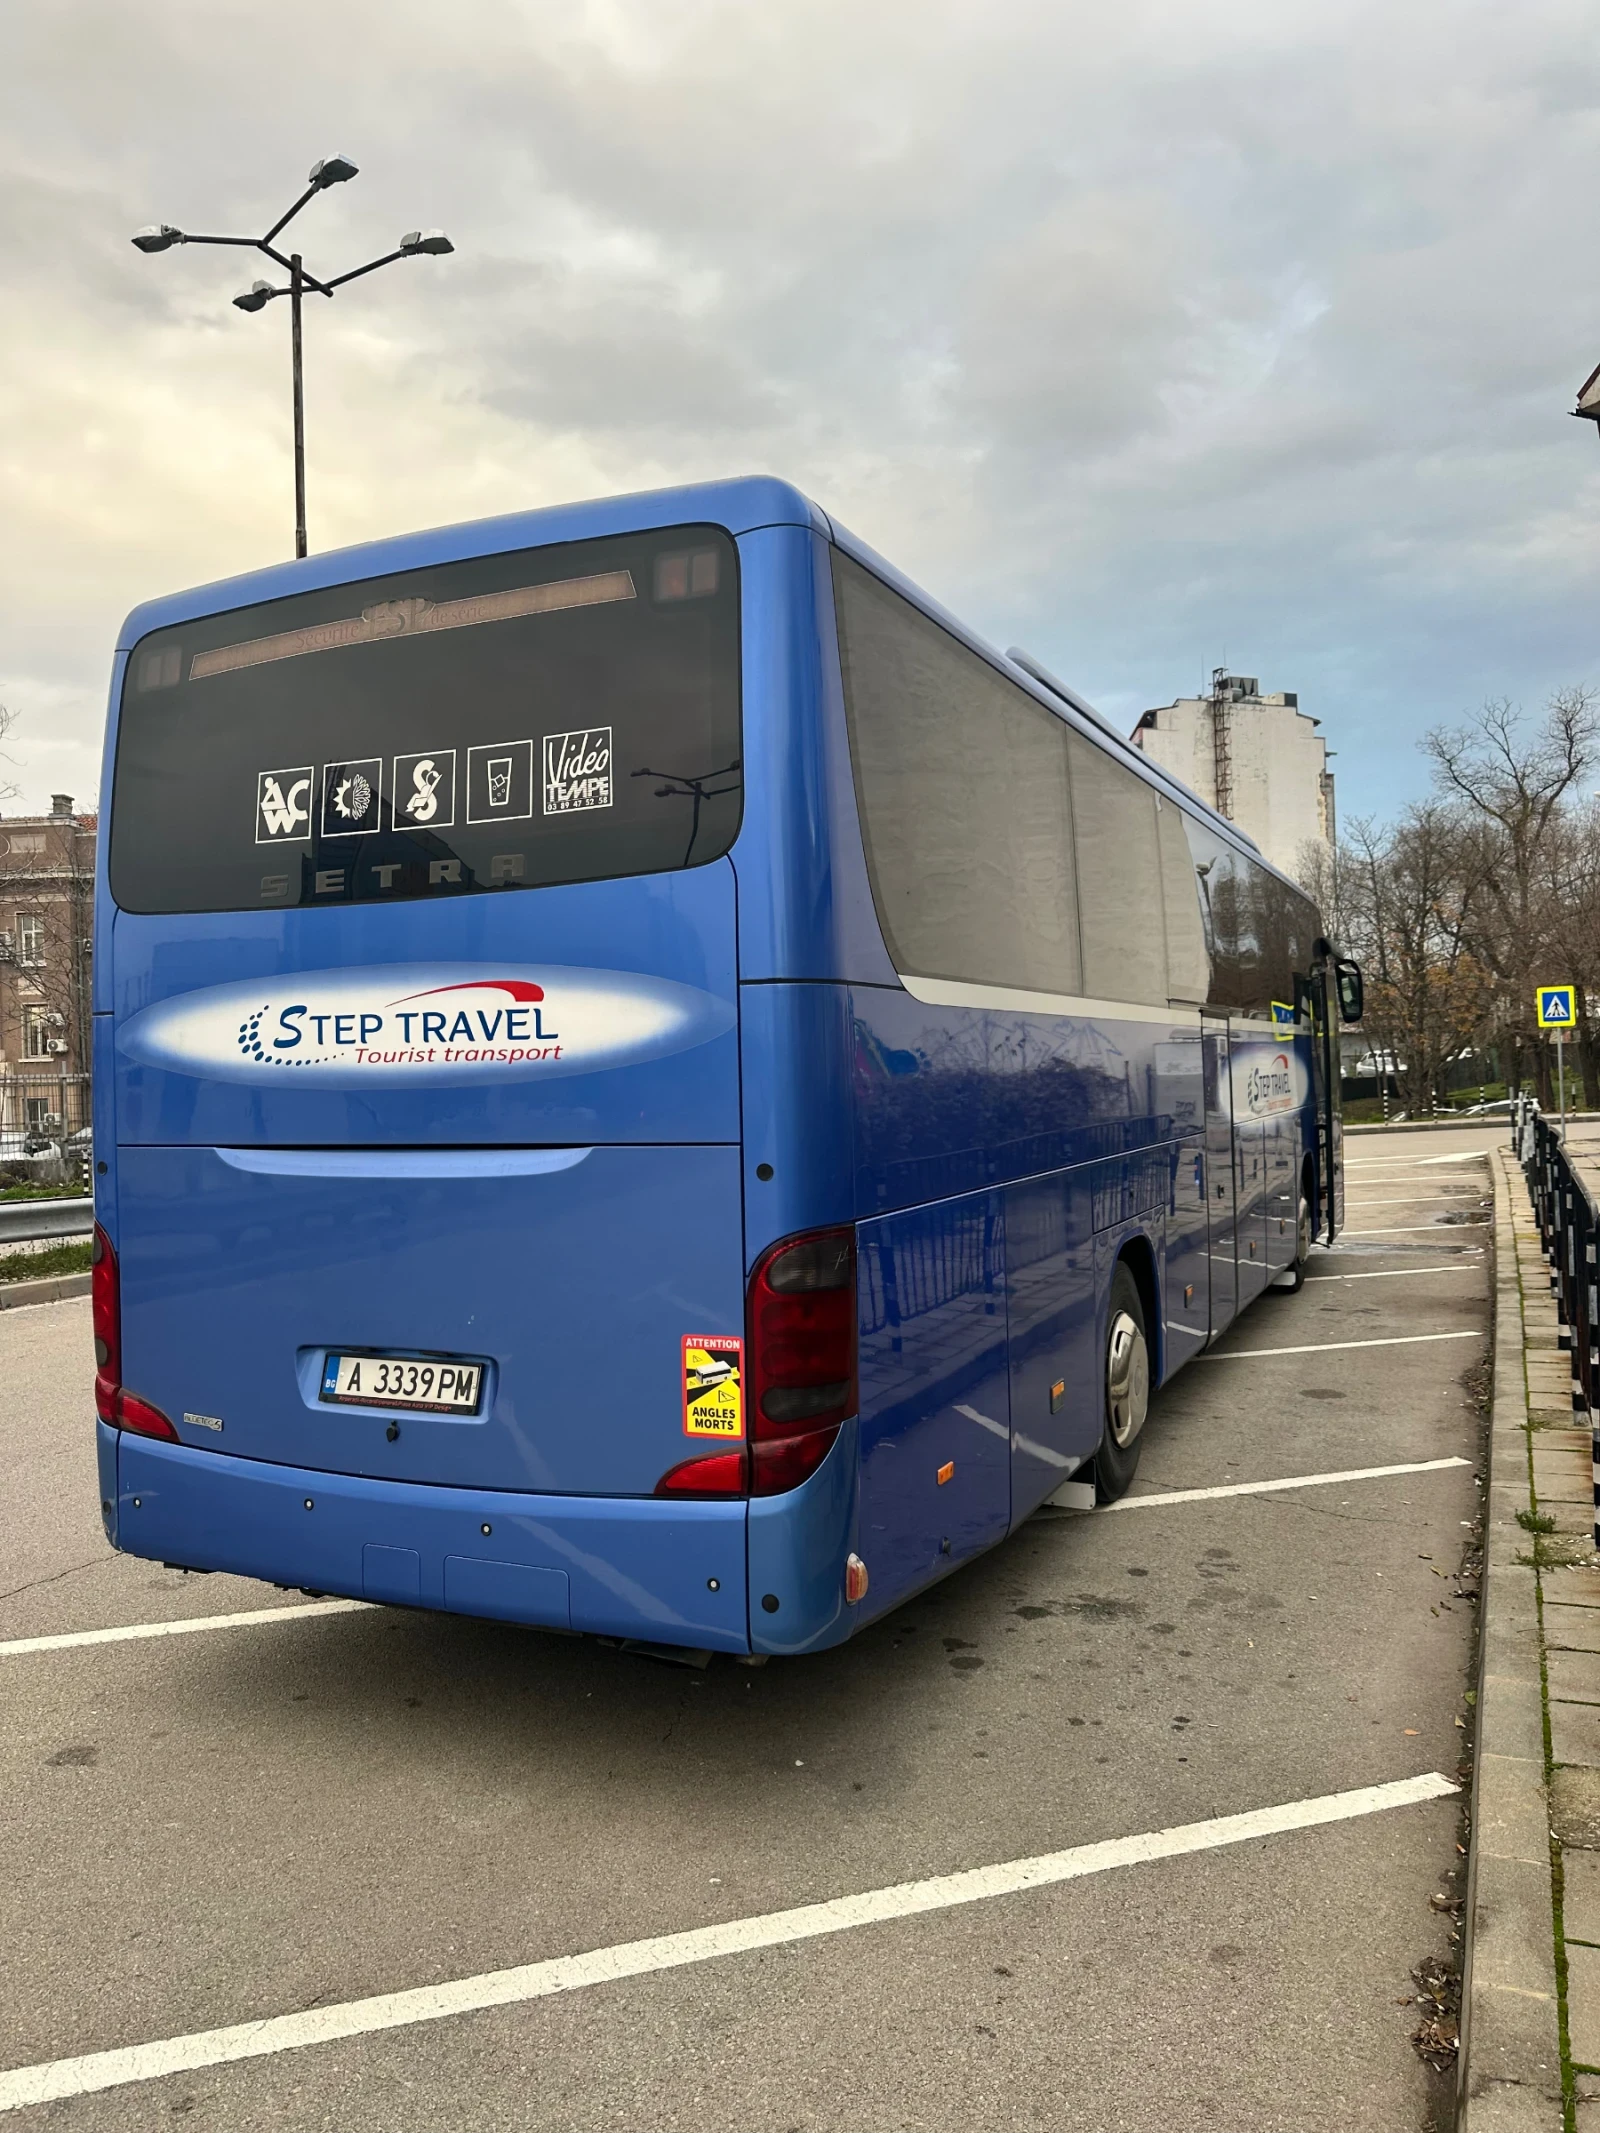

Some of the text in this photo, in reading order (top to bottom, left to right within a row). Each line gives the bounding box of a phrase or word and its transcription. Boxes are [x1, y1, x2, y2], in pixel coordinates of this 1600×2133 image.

[548, 732, 609, 784] Vidéo
[546, 776, 609, 802] TEMPE
[547, 796, 608, 811] 03 89 47 52 58
[260, 854, 525, 898] SETRA
[273, 1004, 559, 1048] STEP TRAVEL
[355, 1045, 563, 1064] Tourist transport
[685, 1338, 740, 1349] ATTENTION
[325, 1379, 337, 1389] BG
[347, 1362, 361, 1392] A
[692, 1406, 735, 1419] ANGLES
[694, 1418, 734, 1431] MORTS
